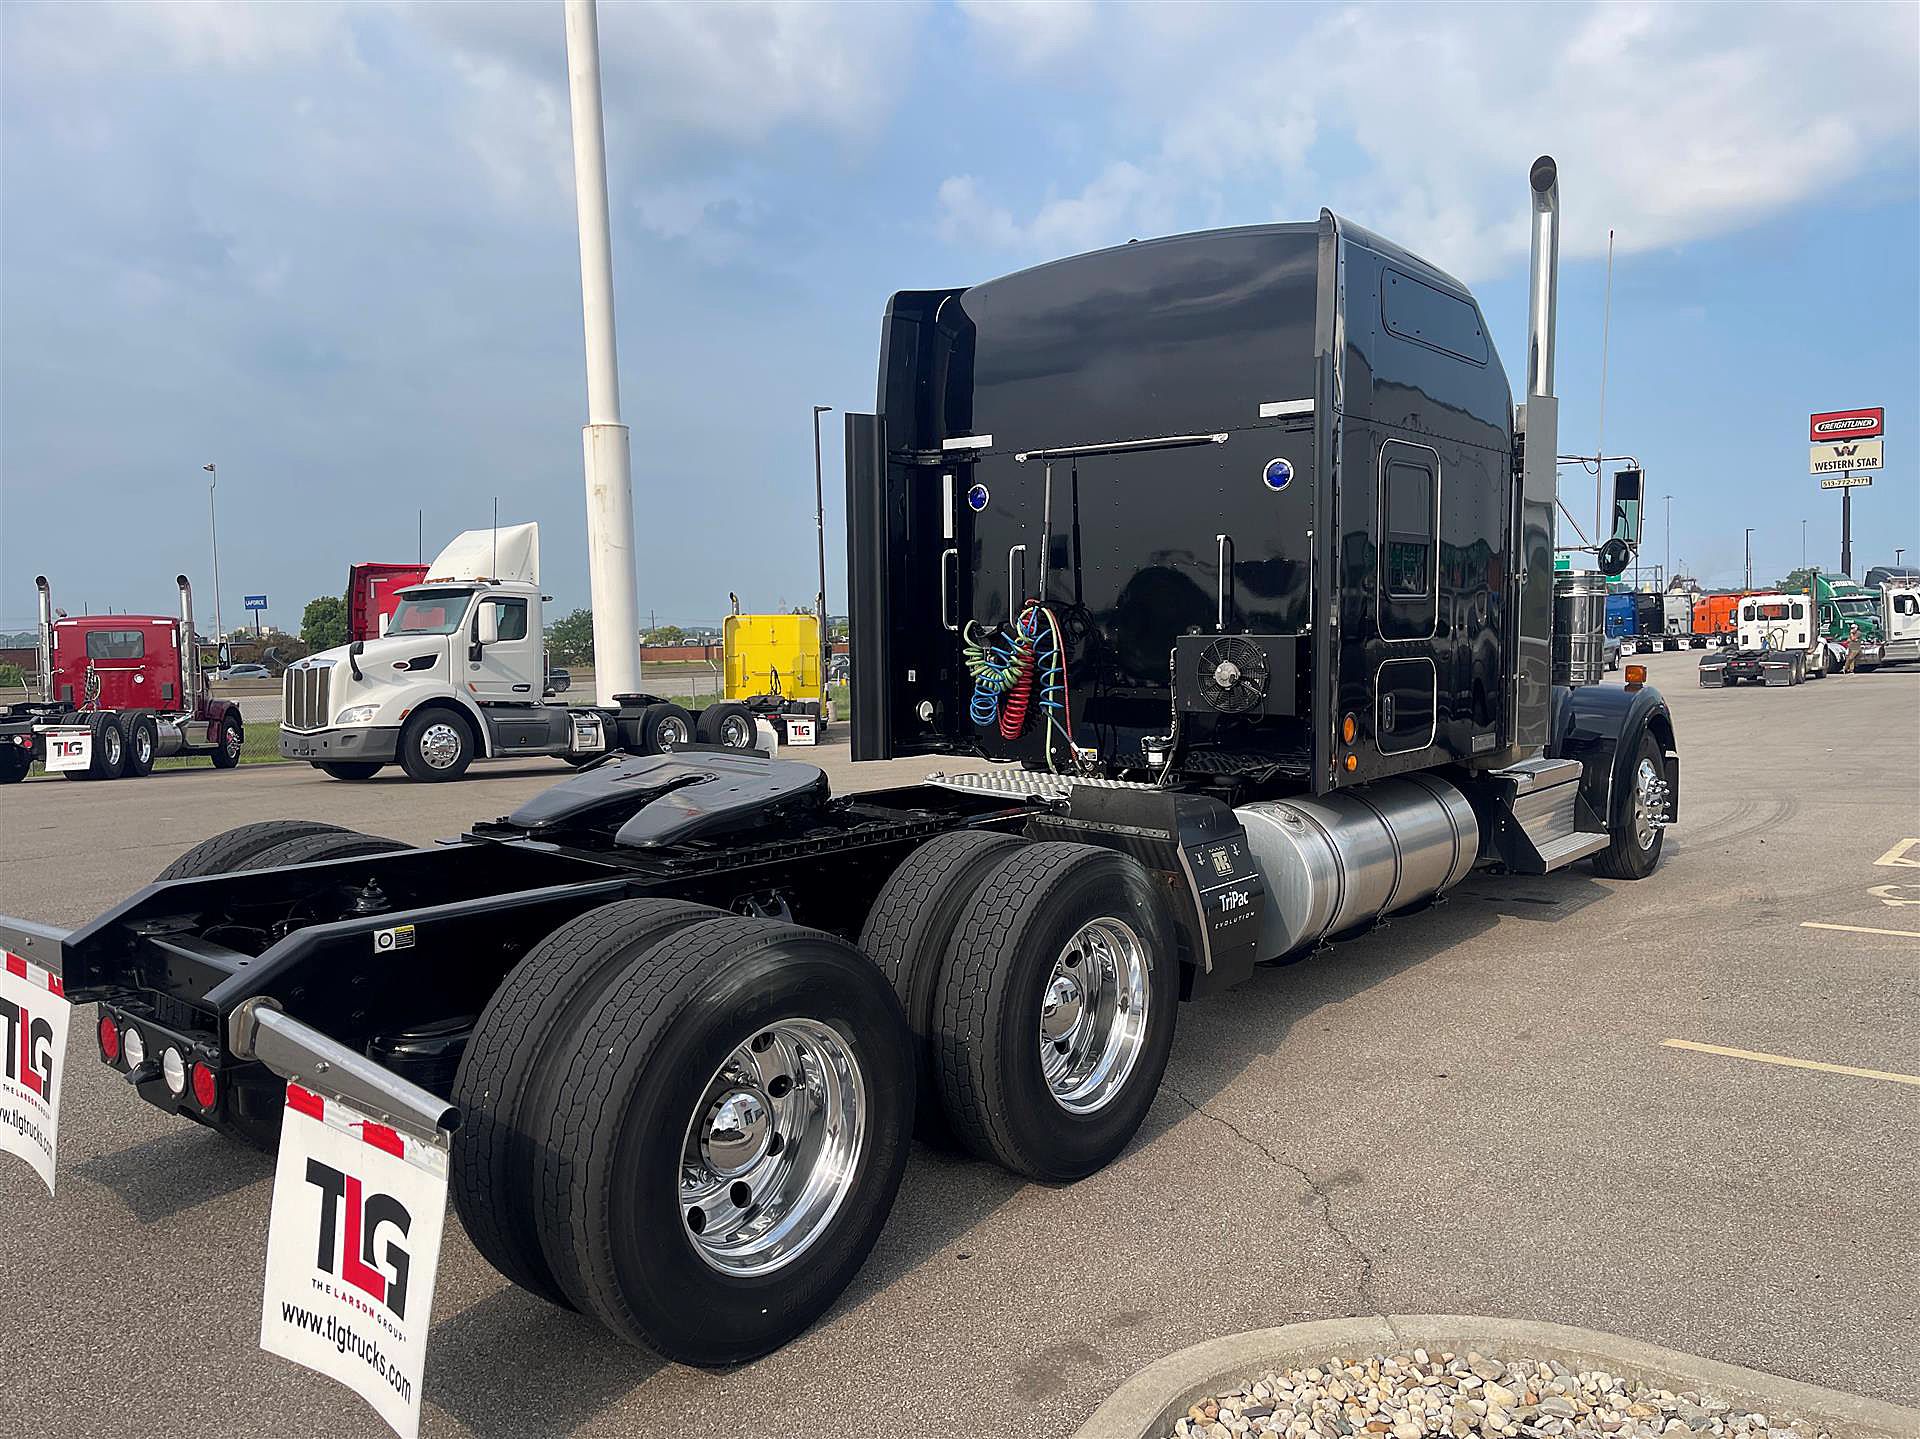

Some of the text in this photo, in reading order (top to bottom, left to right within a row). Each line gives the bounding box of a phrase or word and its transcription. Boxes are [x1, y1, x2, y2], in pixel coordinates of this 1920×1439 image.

[1820, 419, 1873, 431] FREIGHTLINER
[1814, 457, 1878, 472] WESTERN STAR
[1823, 478, 1869, 487] 513-772-7171
[791, 725, 809, 736] TLG
[53, 741, 83, 757] TLG
[1219, 891, 1249, 912] TriPac
[1215, 911, 1255, 929] EVOLUTION
[0, 997, 53, 1105] TLG
[3, 1083, 14, 1095] THE
[305, 1156, 412, 1322] TLG
[312, 1278, 331, 1294] THE
[333, 1288, 375, 1319] LARSON
[281, 1301, 412, 1405] www.tlgtrucks.com
